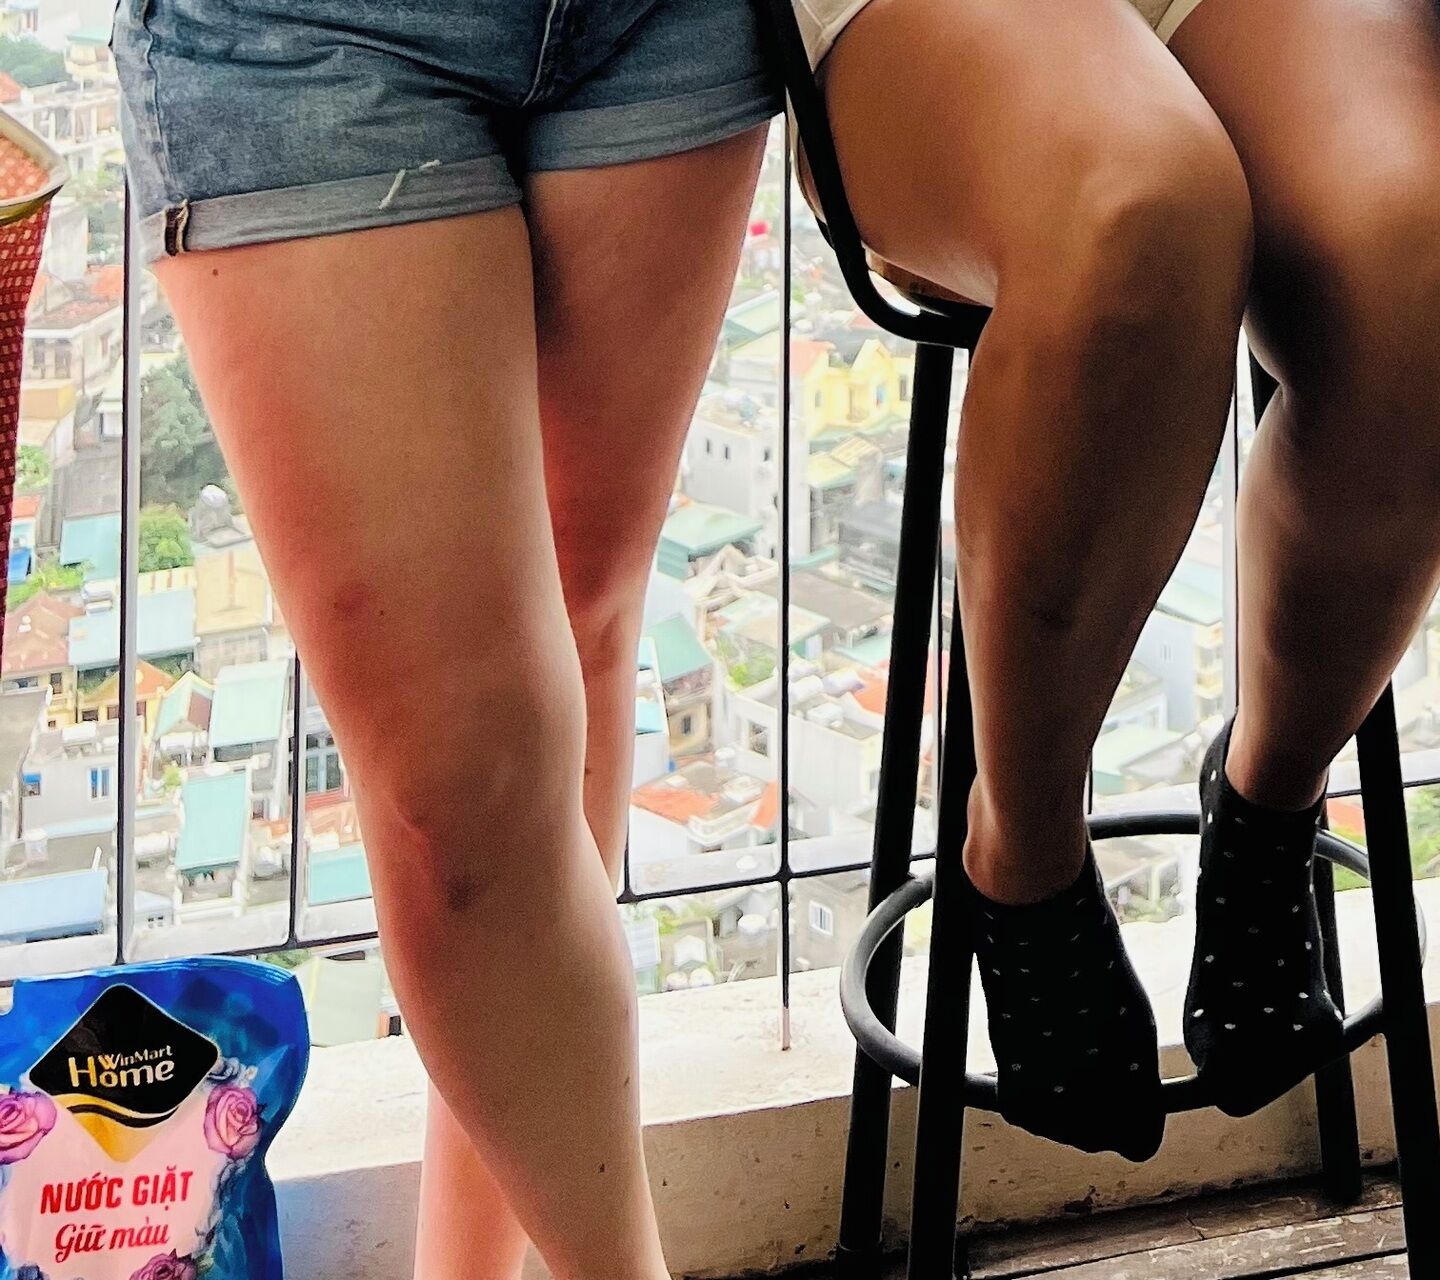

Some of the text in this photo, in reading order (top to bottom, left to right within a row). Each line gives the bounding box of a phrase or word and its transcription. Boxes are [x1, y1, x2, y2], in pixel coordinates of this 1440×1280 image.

[68, 1056, 175, 1088] Home
[98, 1045, 173, 1070] WinMart
[40, 1165, 194, 1214] NƯỚC GIẶT
[55, 1224, 107, 1263] Giữ
